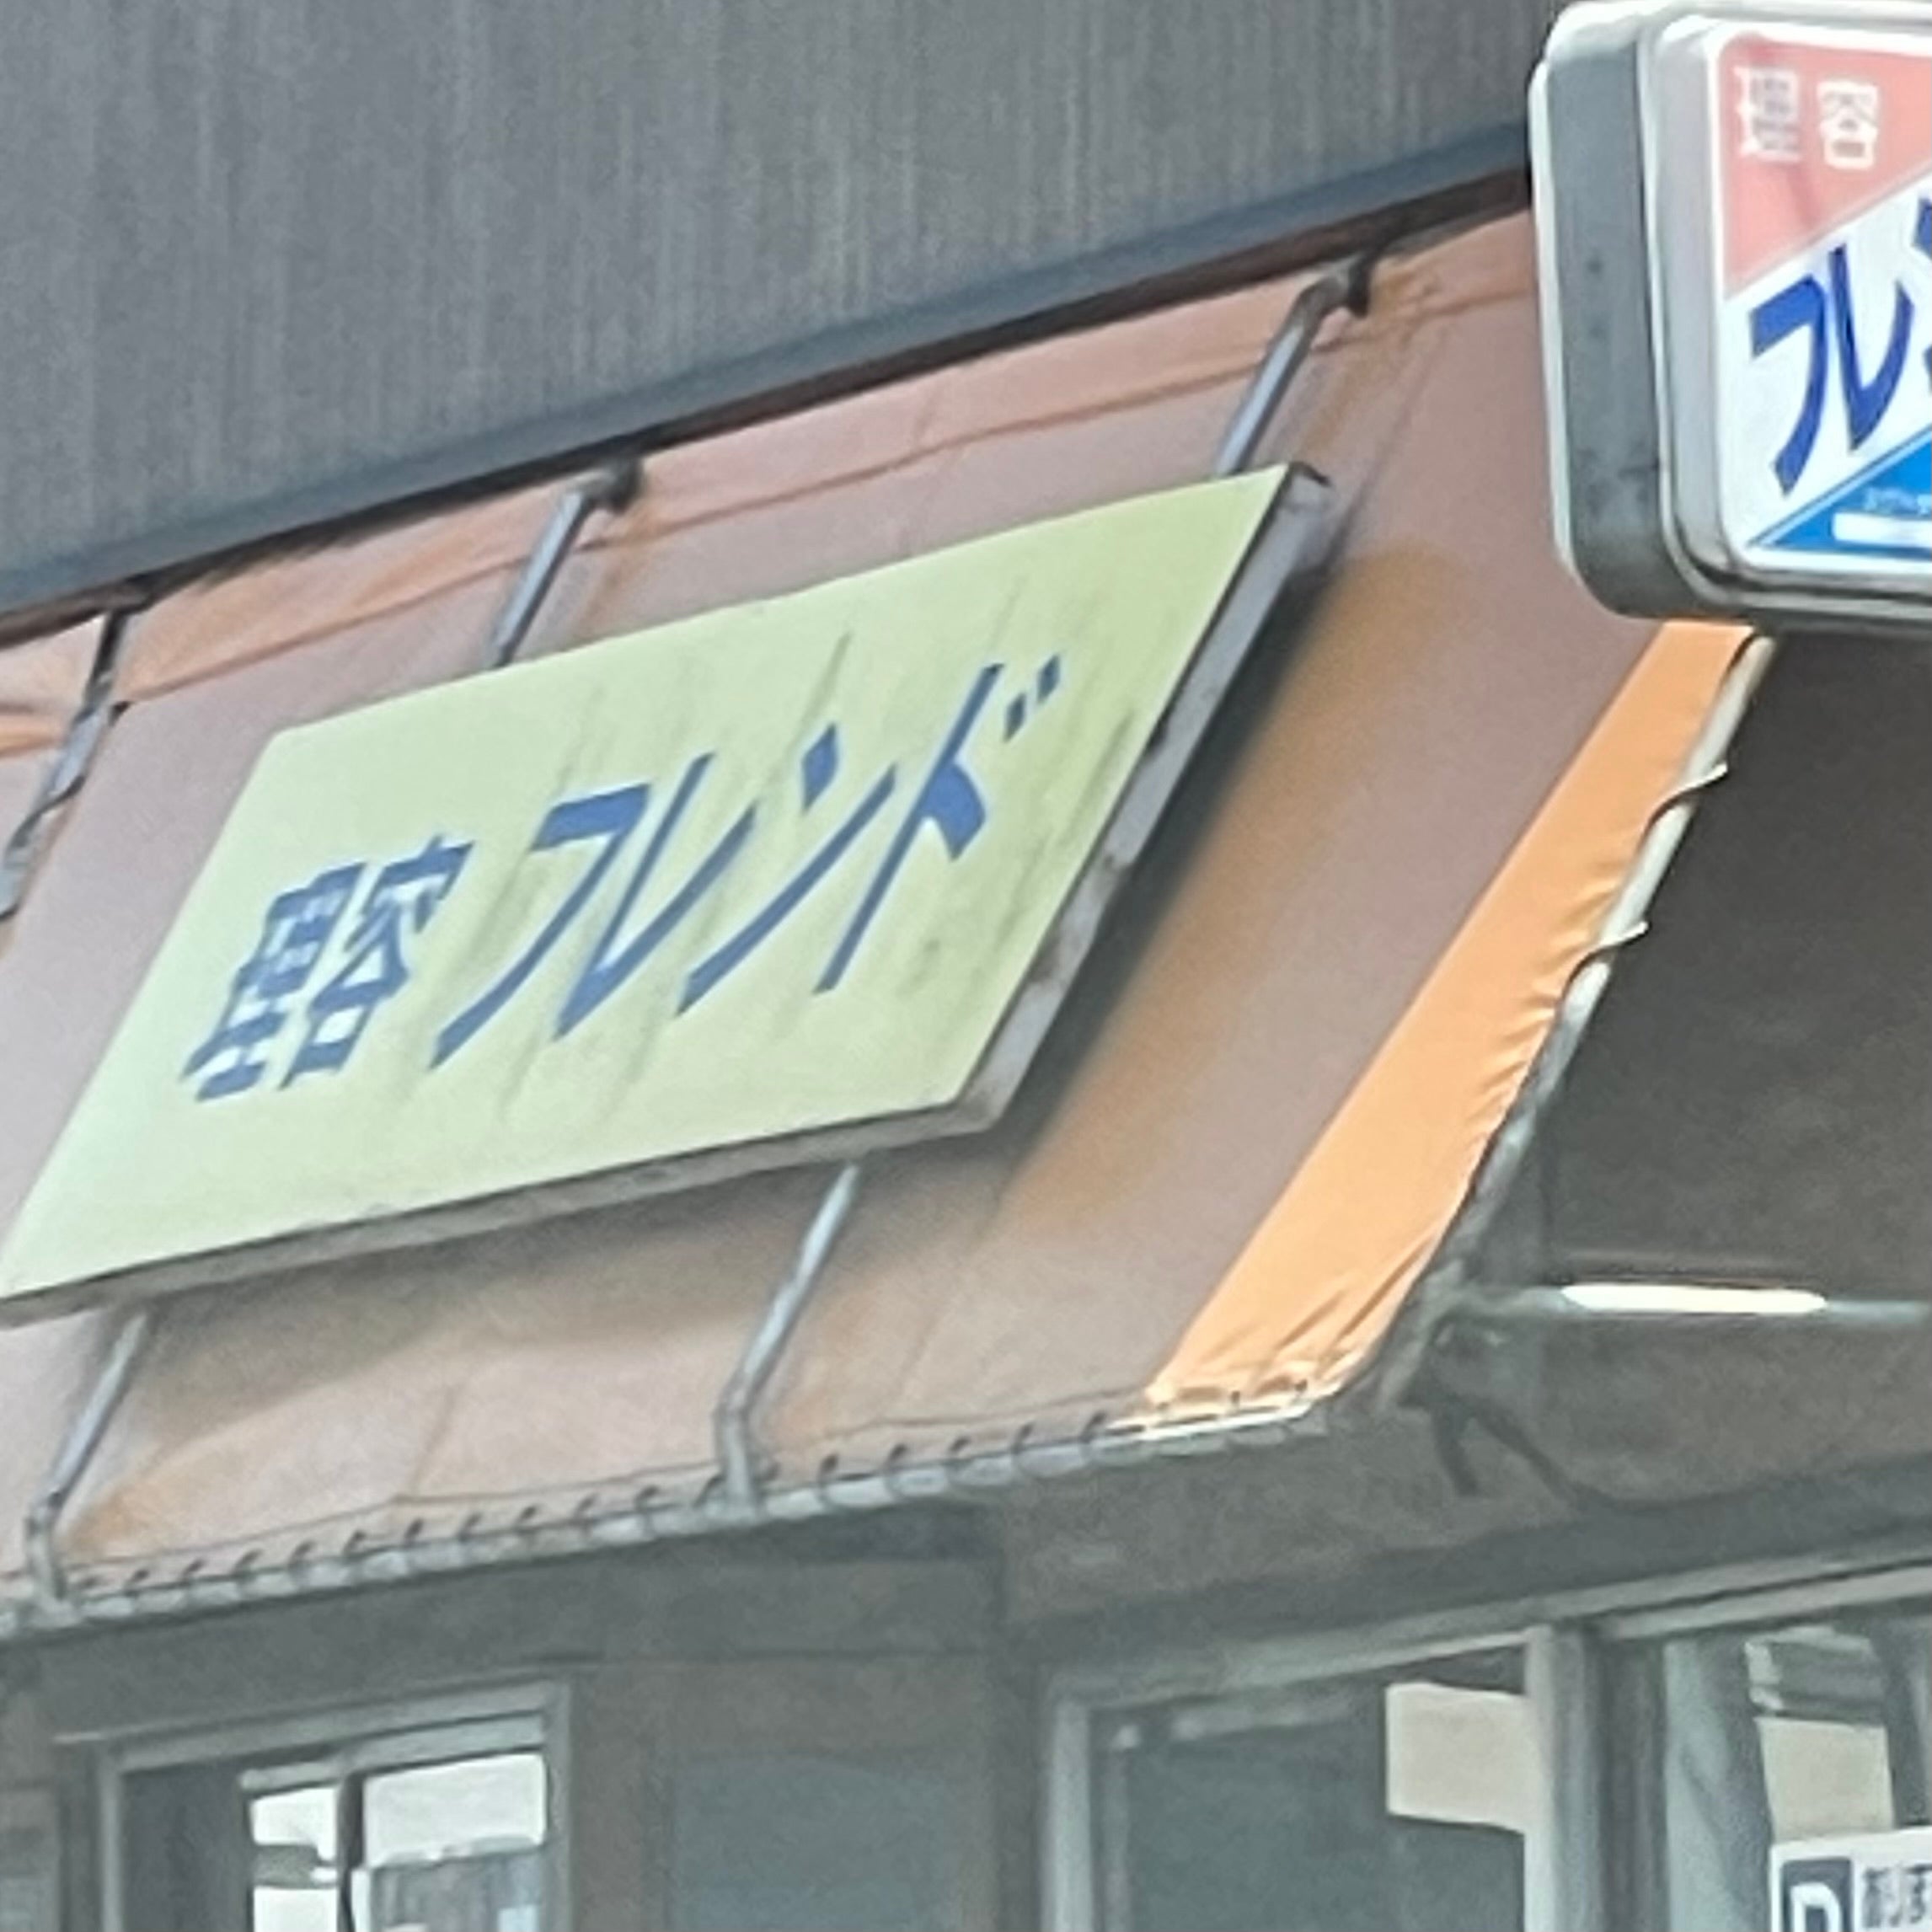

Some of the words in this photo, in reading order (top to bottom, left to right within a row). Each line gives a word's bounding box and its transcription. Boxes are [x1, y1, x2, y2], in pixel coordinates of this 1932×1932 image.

[1749, 196, 1932, 497] フレ
[179, 833, 475, 1102] 理容
[430, 657, 1063, 1066] フレンド
